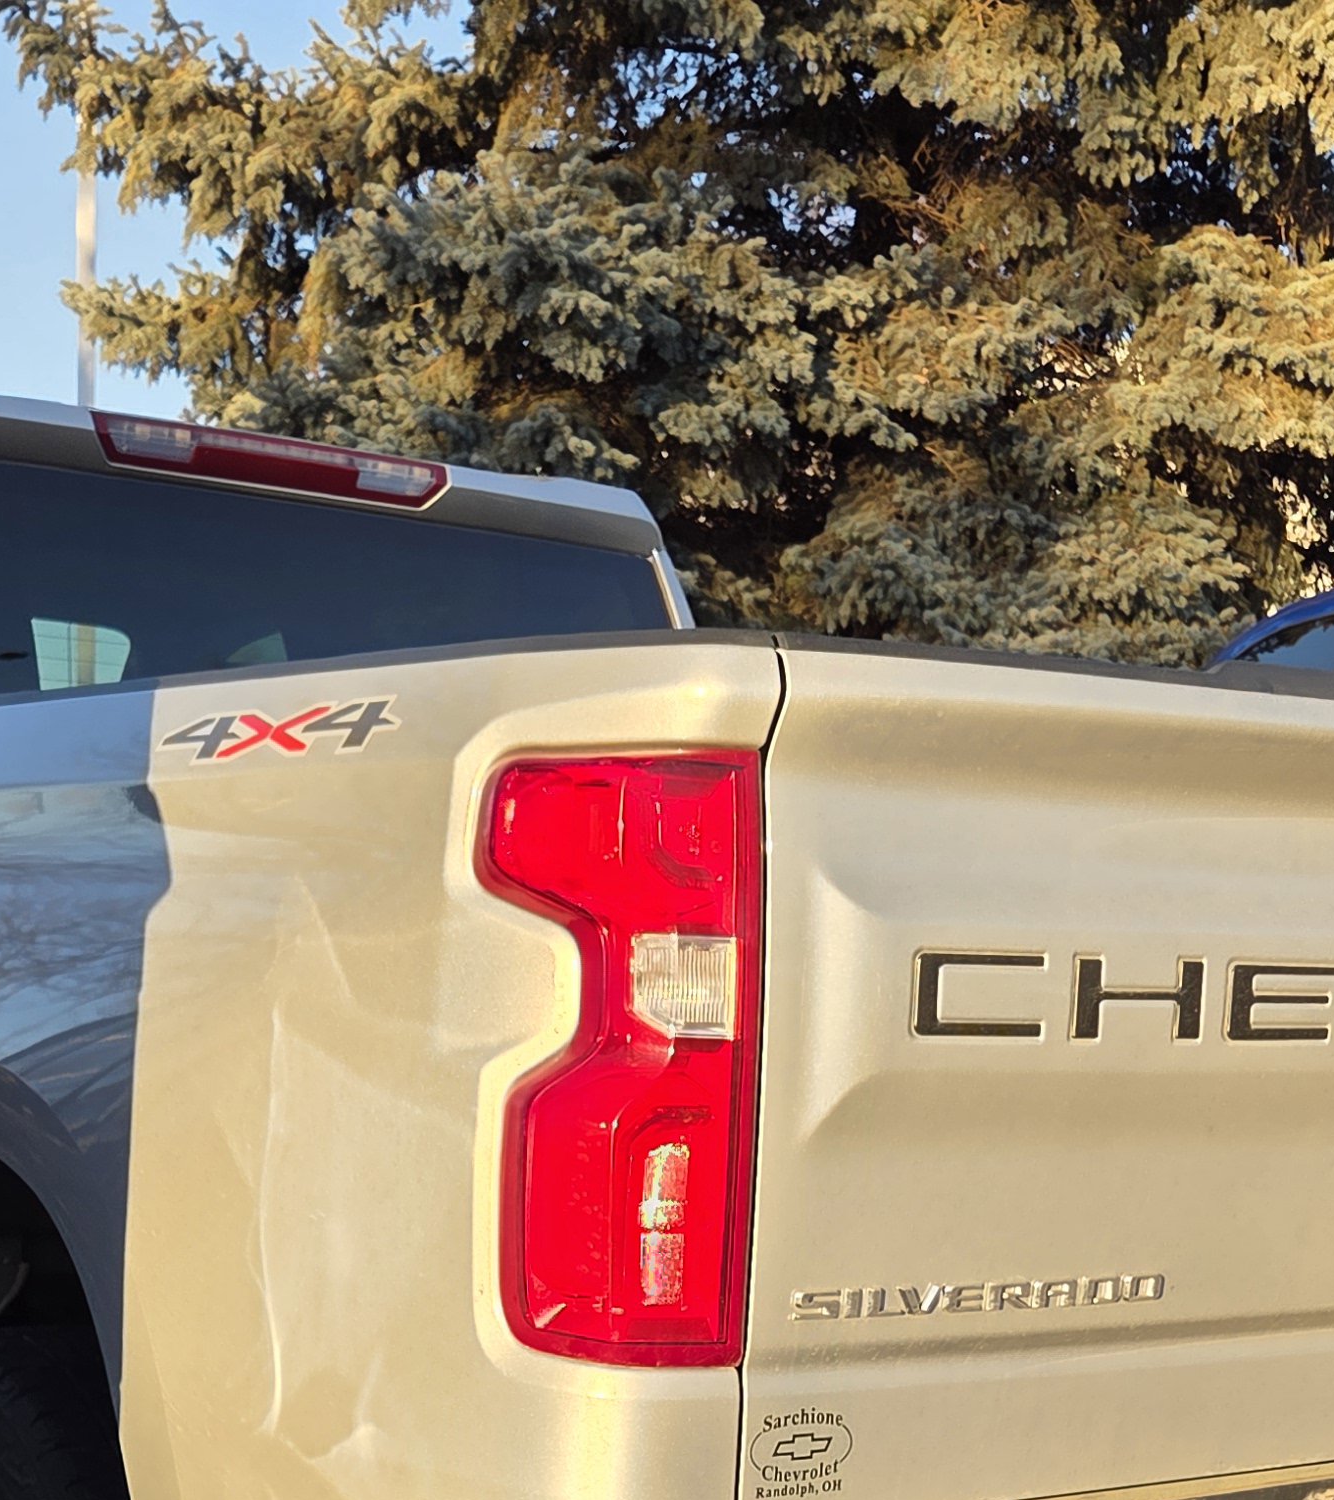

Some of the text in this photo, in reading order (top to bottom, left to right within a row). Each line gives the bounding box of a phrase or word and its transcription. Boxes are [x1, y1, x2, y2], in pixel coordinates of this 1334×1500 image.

[788, 1273, 1166, 1320] SILVERADO
[762, 1407, 843, 1433] Sarchione
[761, 1458, 839, 1482] Chevrolet
[755, 1479, 842, 1499] Randolph, OH
